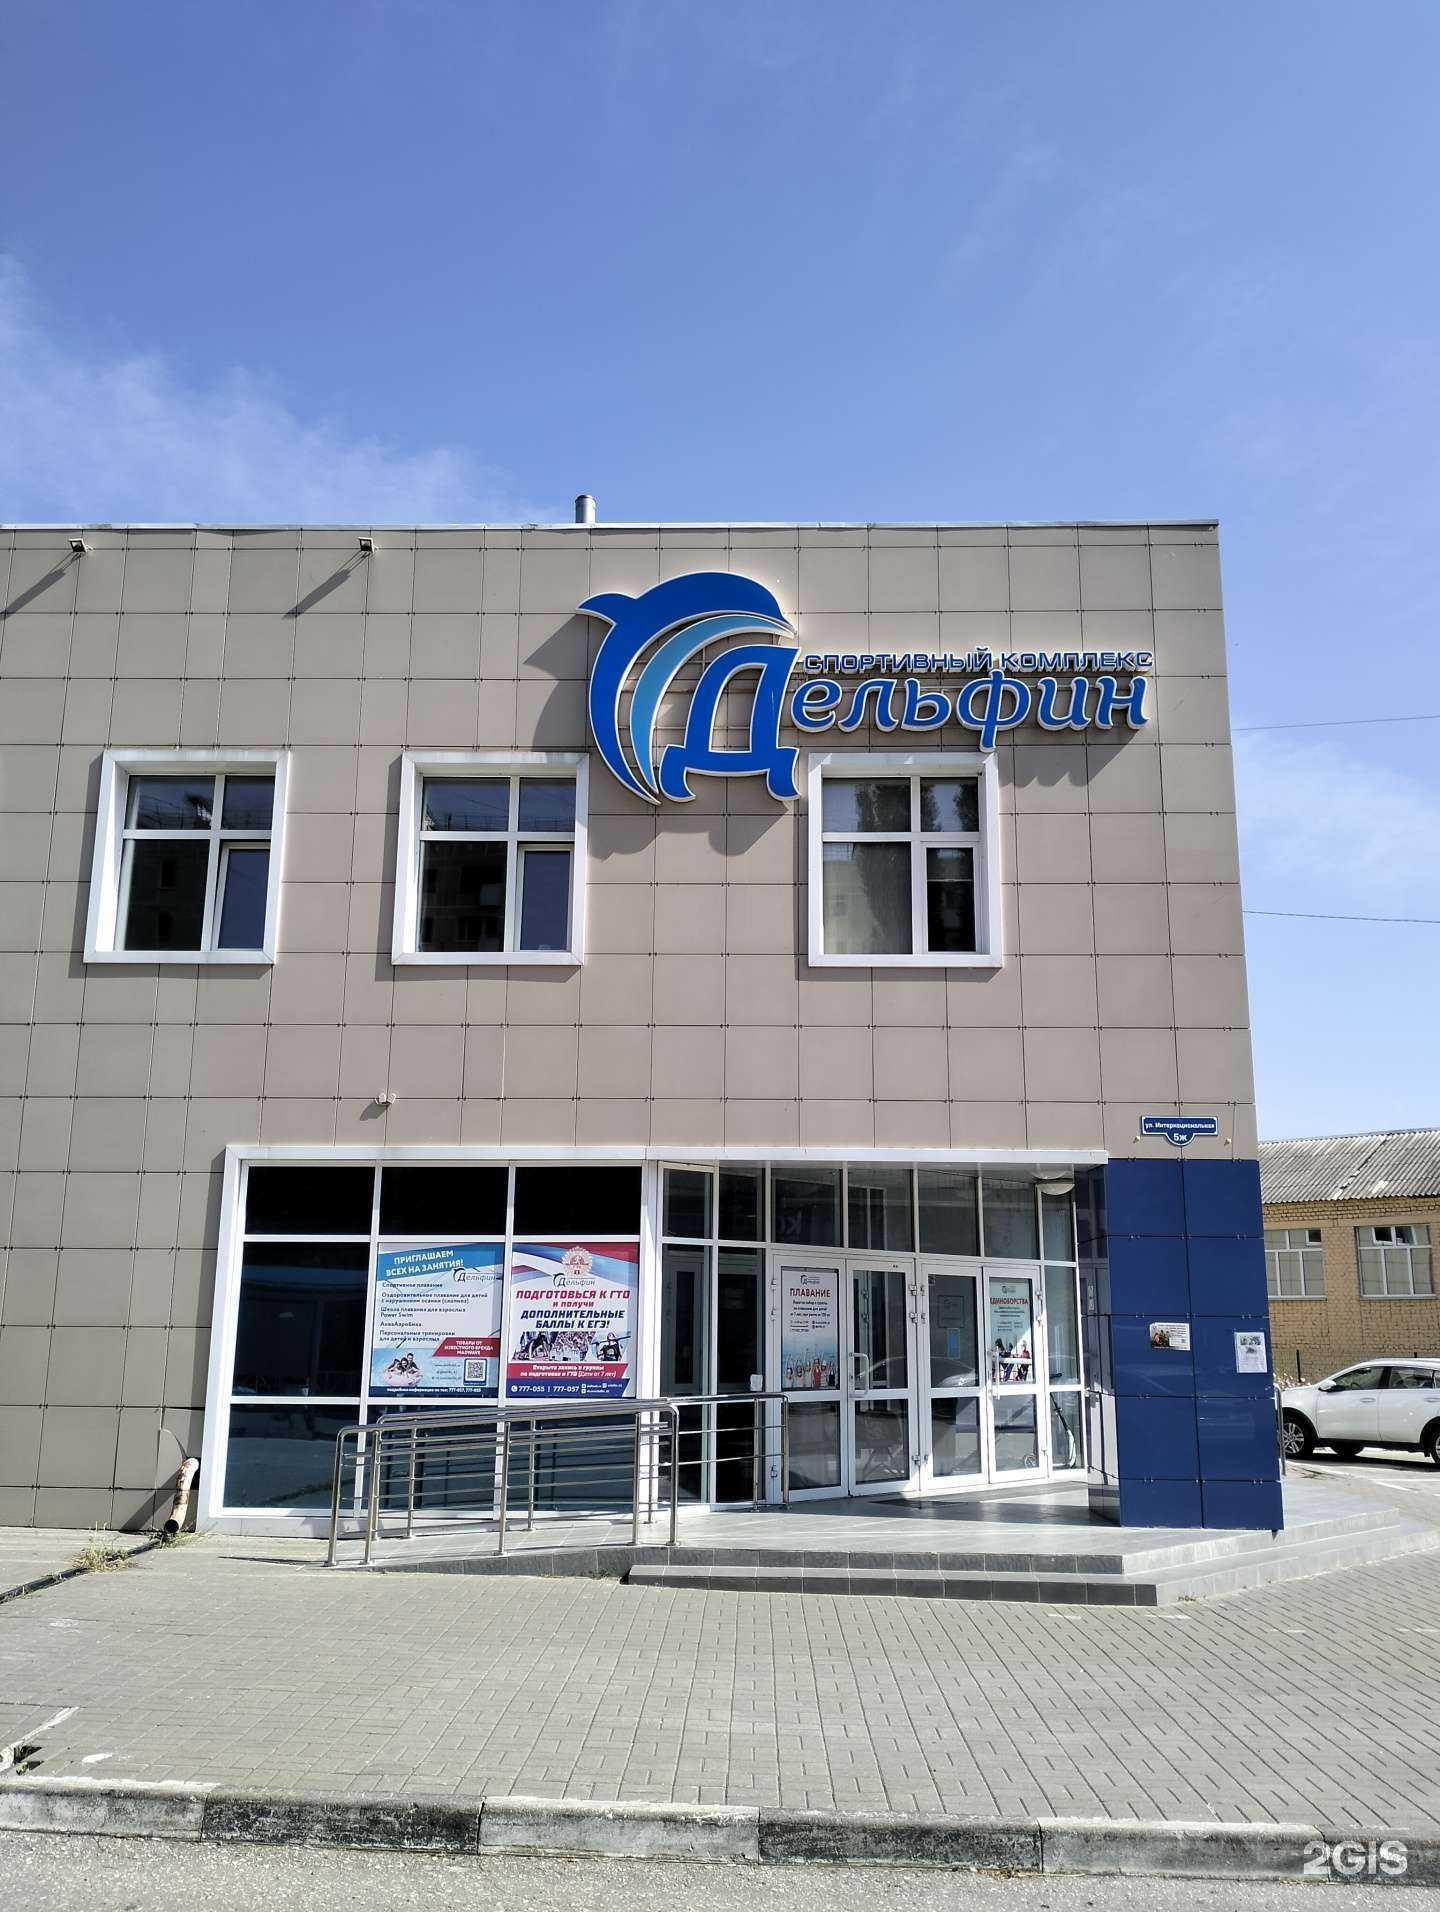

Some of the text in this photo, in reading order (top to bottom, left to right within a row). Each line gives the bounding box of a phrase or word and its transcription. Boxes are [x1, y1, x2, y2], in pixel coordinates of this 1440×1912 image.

[803, 646, 1154, 674] СПОРТИВНЫЙ КОМПЛЕКС
[658, 644, 1152, 803] Дельфин
[1173, 1133, 1188, 1141] 5ж
[394, 1250, 454, 1264] ПРИГЛАШАЕМ
[386, 1259, 464, 1276] ВСЕХ НА ЗАНЯТИЯ!
[557, 1276, 595, 1287] Дельфин
[516, 1290, 630, 1300] ПОДГОТОВЬСЯ К ГТО
[790, 1288, 831, 1297] ПЛАВАНИЕ
[560, 1301, 594, 1309] получи
[520, 1310, 625, 1319] ДОПОЛНИТЕЛЬНЫЕ
[535, 1320, 610, 1328] БАЛЛЫ К ЕГЭ!
